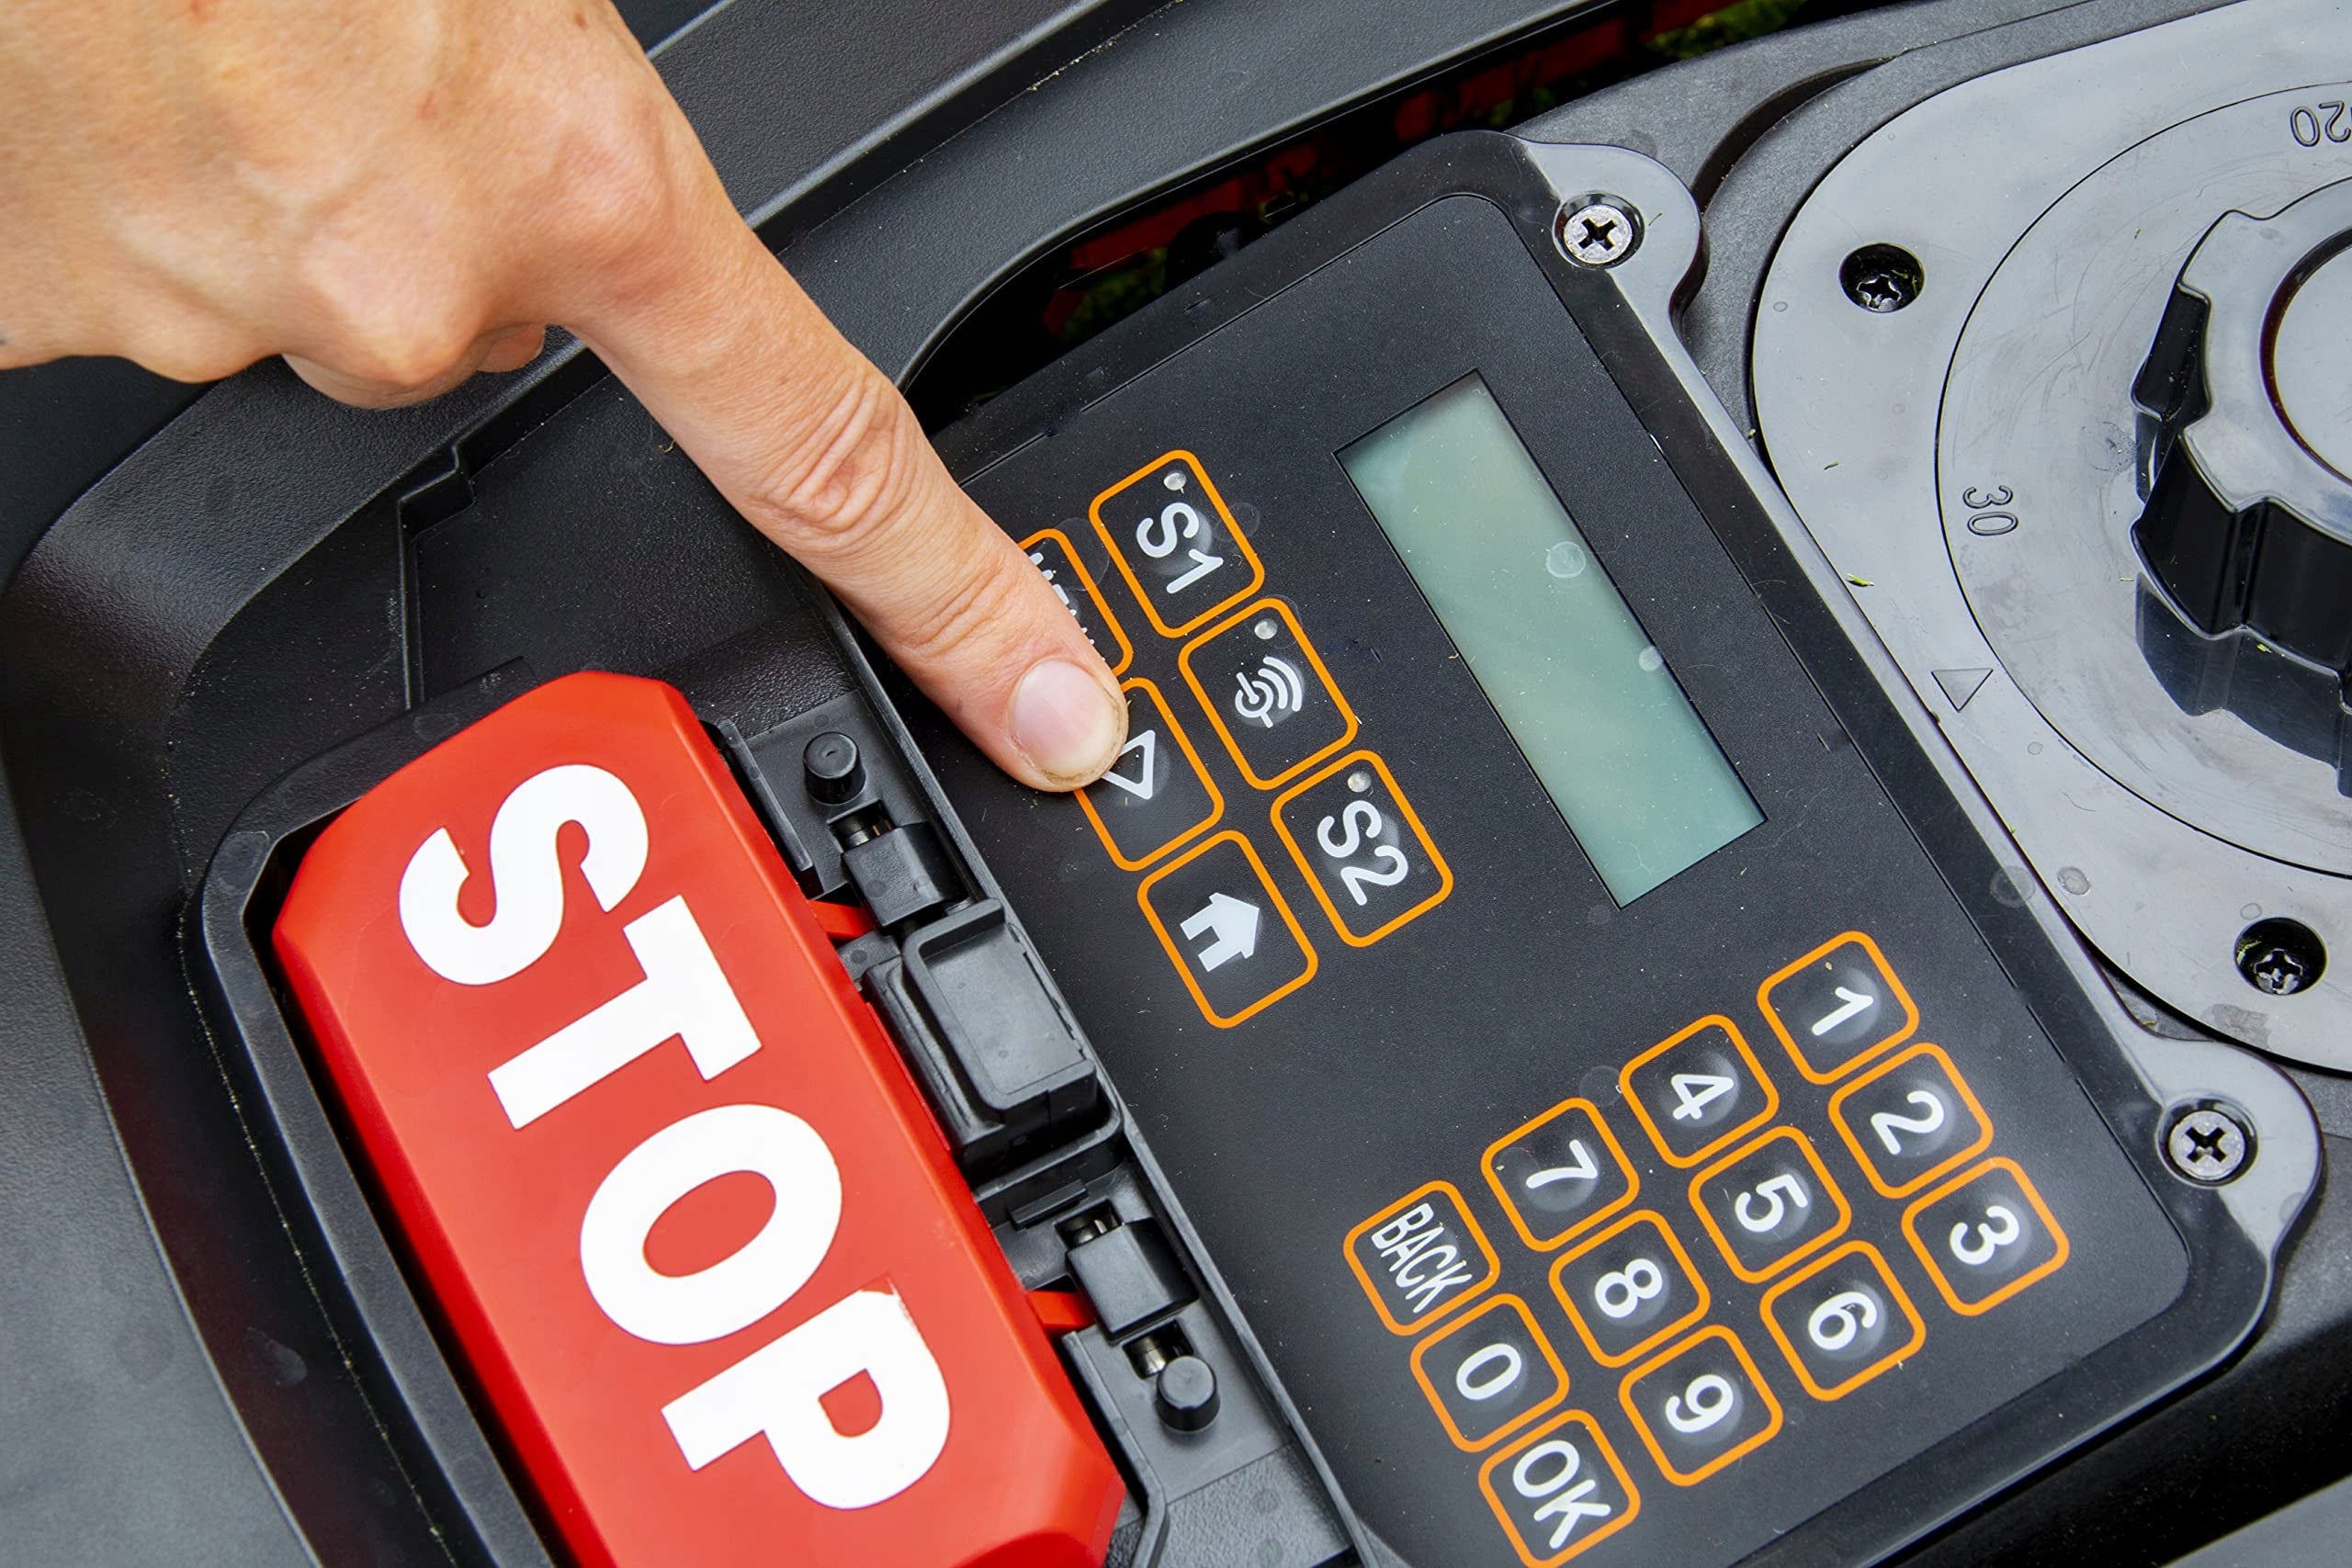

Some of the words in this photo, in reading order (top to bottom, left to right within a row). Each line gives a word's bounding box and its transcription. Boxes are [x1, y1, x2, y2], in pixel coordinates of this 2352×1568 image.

[1962, 485, 2019, 537] 30
[1136, 502, 1225, 595] S1
[1317, 799, 1409, 907] S2
[1811, 986, 1874, 1037] 1
[1669, 1073, 1736, 1122] 4
[1870, 1089, 1946, 1156] 2
[399, 763, 951, 1509] STOP
[1525, 1139, 1599, 1190] 7
[1734, 1173, 1811, 1234] 5
[1370, 1202, 1474, 1314] BACK
[1949, 1204, 2020, 1266] 3
[1594, 1258, 1664, 1319] 8
[1807, 1290, 1878, 1350] 6
[1665, 1373, 1734, 1433] 9
[1511, 1439, 1612, 1550] OK
